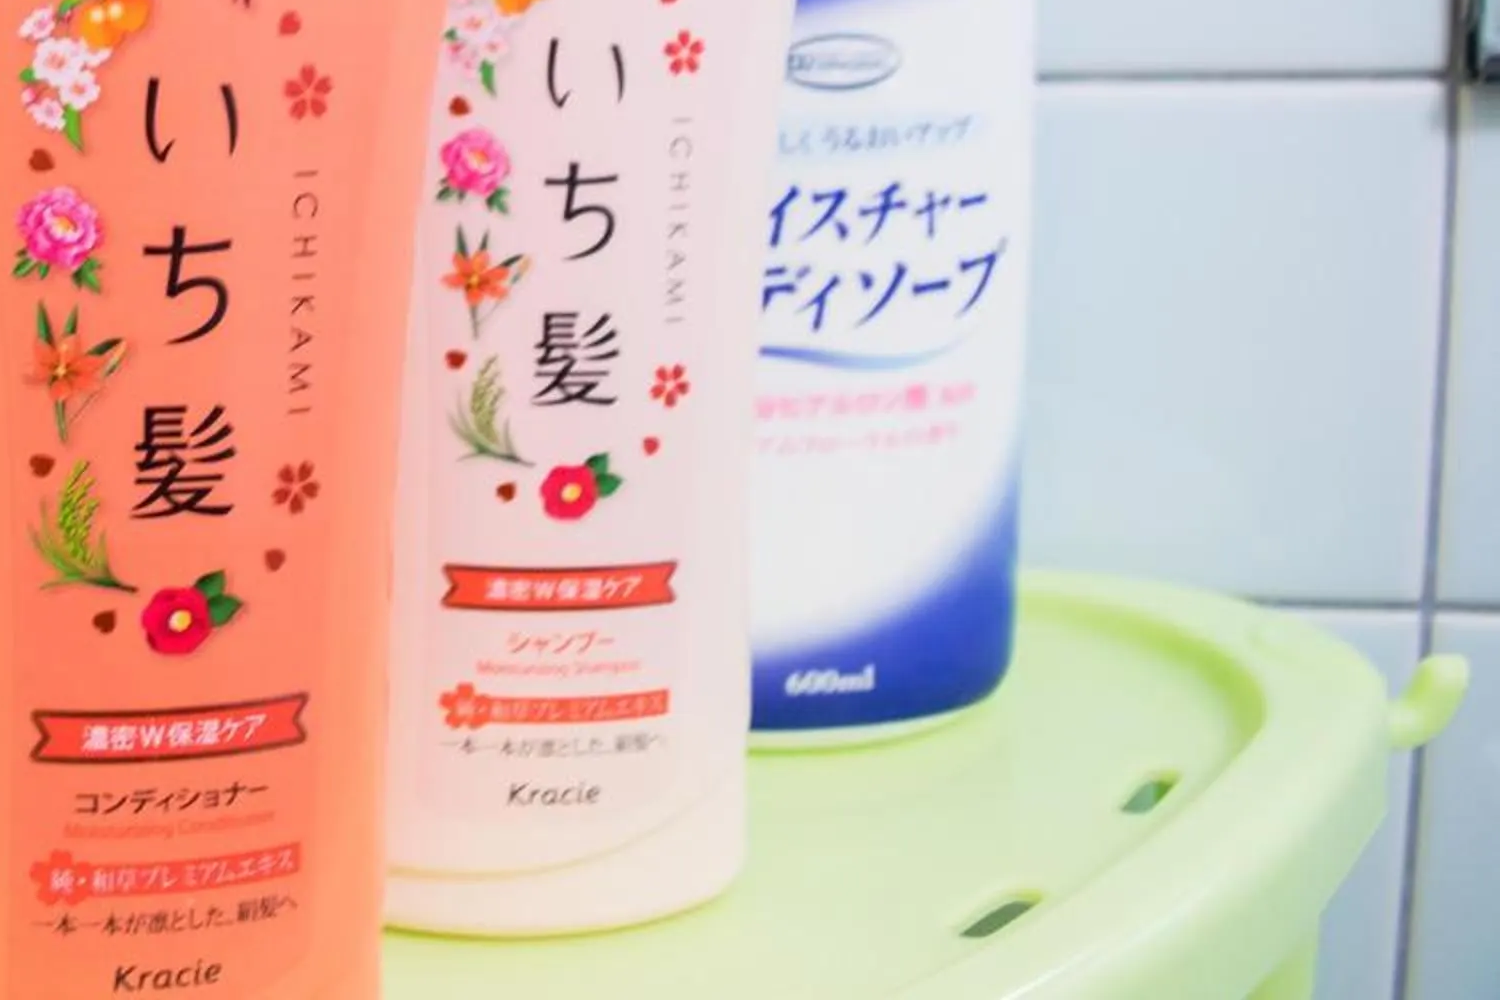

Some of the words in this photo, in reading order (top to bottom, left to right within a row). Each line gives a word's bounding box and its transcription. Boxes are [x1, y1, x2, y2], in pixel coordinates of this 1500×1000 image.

[531, 37, 625, 407] いち髪
[665, 116, 692, 324] ICHIKAMI
[129, 76, 239, 519] いち髪
[288, 169, 319, 416] ICHIKAMI
[785, 663, 876, 697] 600ml
[81, 714, 267, 752] 濃密W保湿ケア
[75, 781, 269, 815] コンディショナー
[506, 780, 601, 806] Kracie
[112, 957, 222, 993] Kracie
